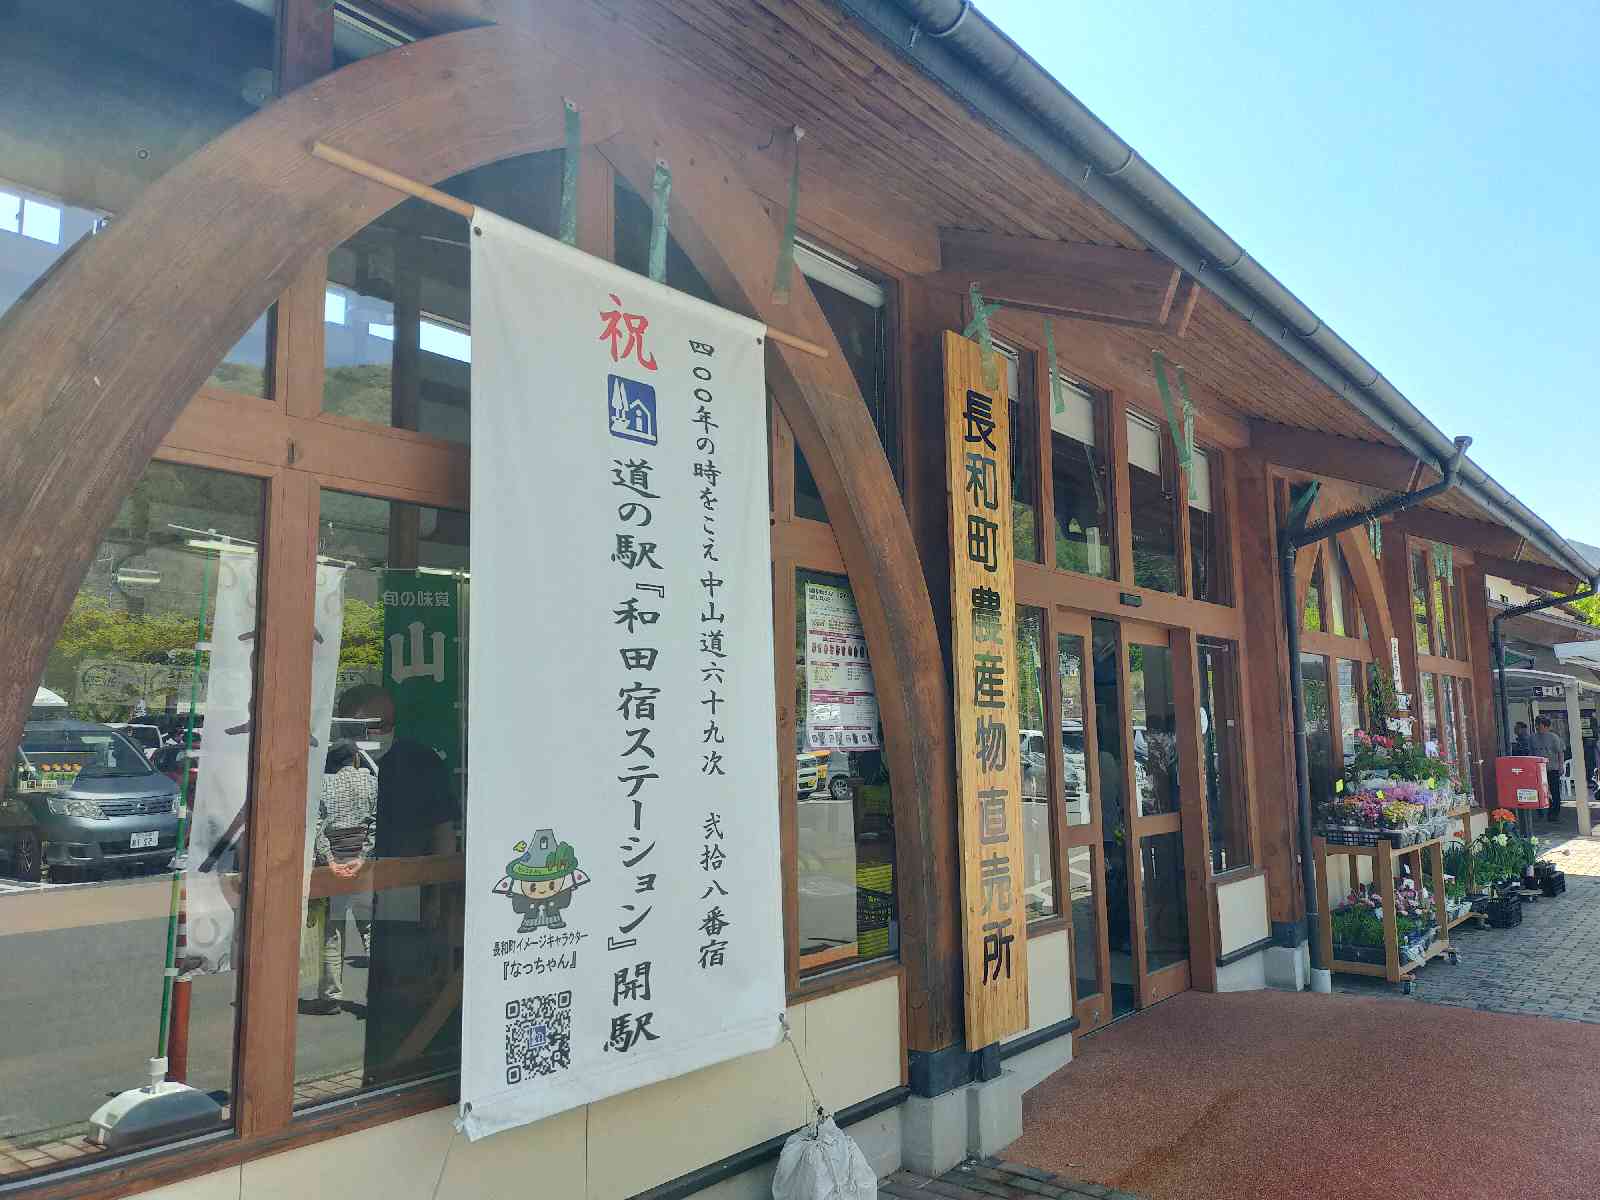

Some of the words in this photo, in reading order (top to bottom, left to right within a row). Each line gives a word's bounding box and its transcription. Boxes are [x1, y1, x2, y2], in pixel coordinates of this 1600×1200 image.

[599, 293, 658, 371] 祝
[963, 389, 1014, 988] 長和町農産物直売所
